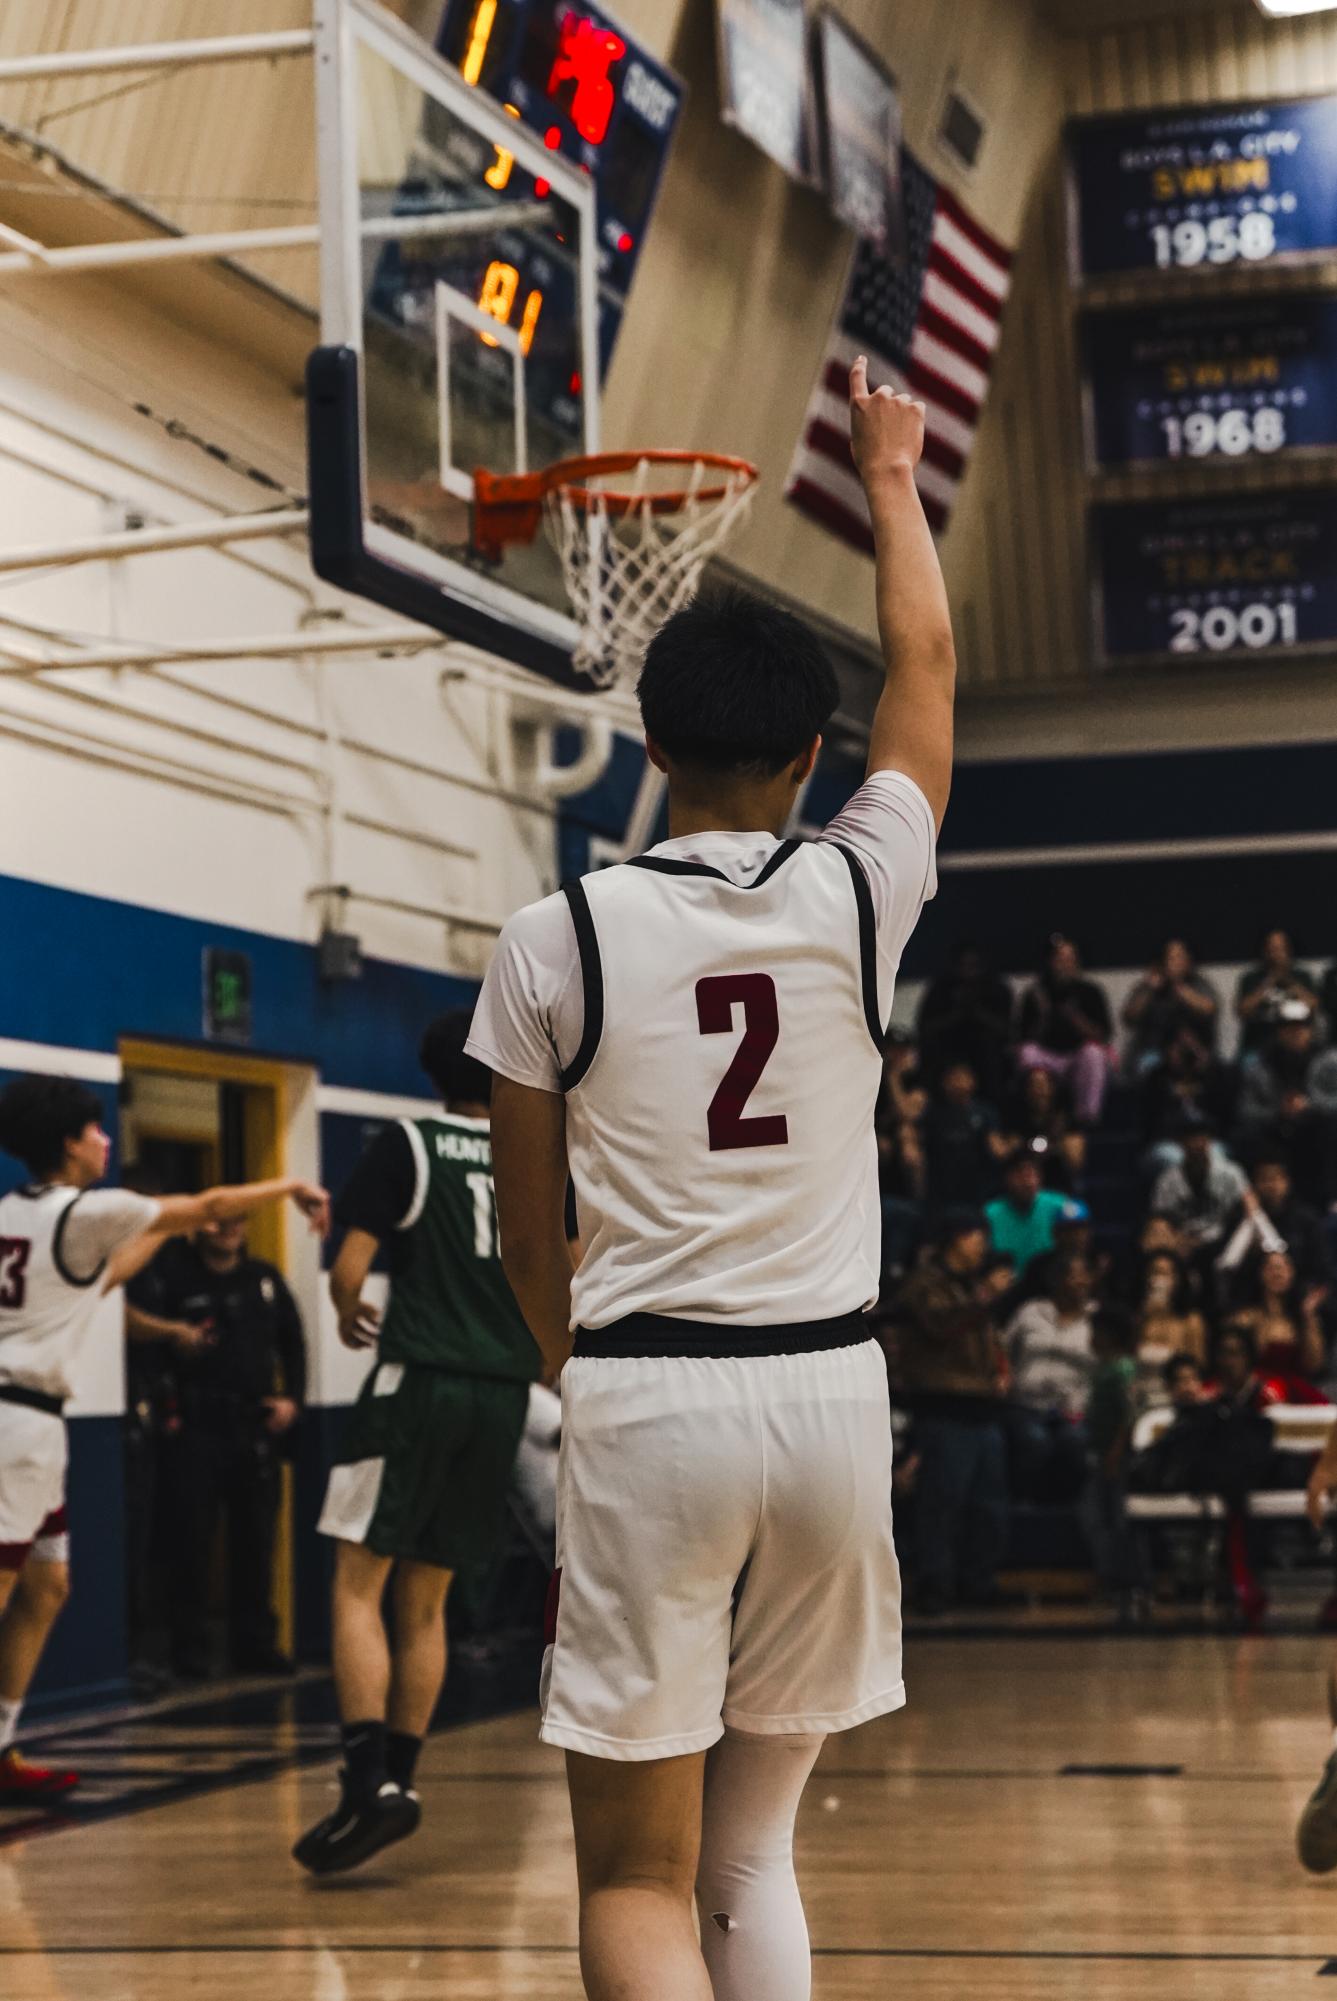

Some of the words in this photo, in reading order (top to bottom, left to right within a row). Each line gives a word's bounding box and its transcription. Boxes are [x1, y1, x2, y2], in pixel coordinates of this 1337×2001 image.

[1153, 157, 1270, 200] SWIM
[1152, 212, 1276, 268] 1958
[1161, 407, 1286, 458] 1968
[1168, 601, 1297, 653] 2001
[695, 973, 788, 1151] 2
